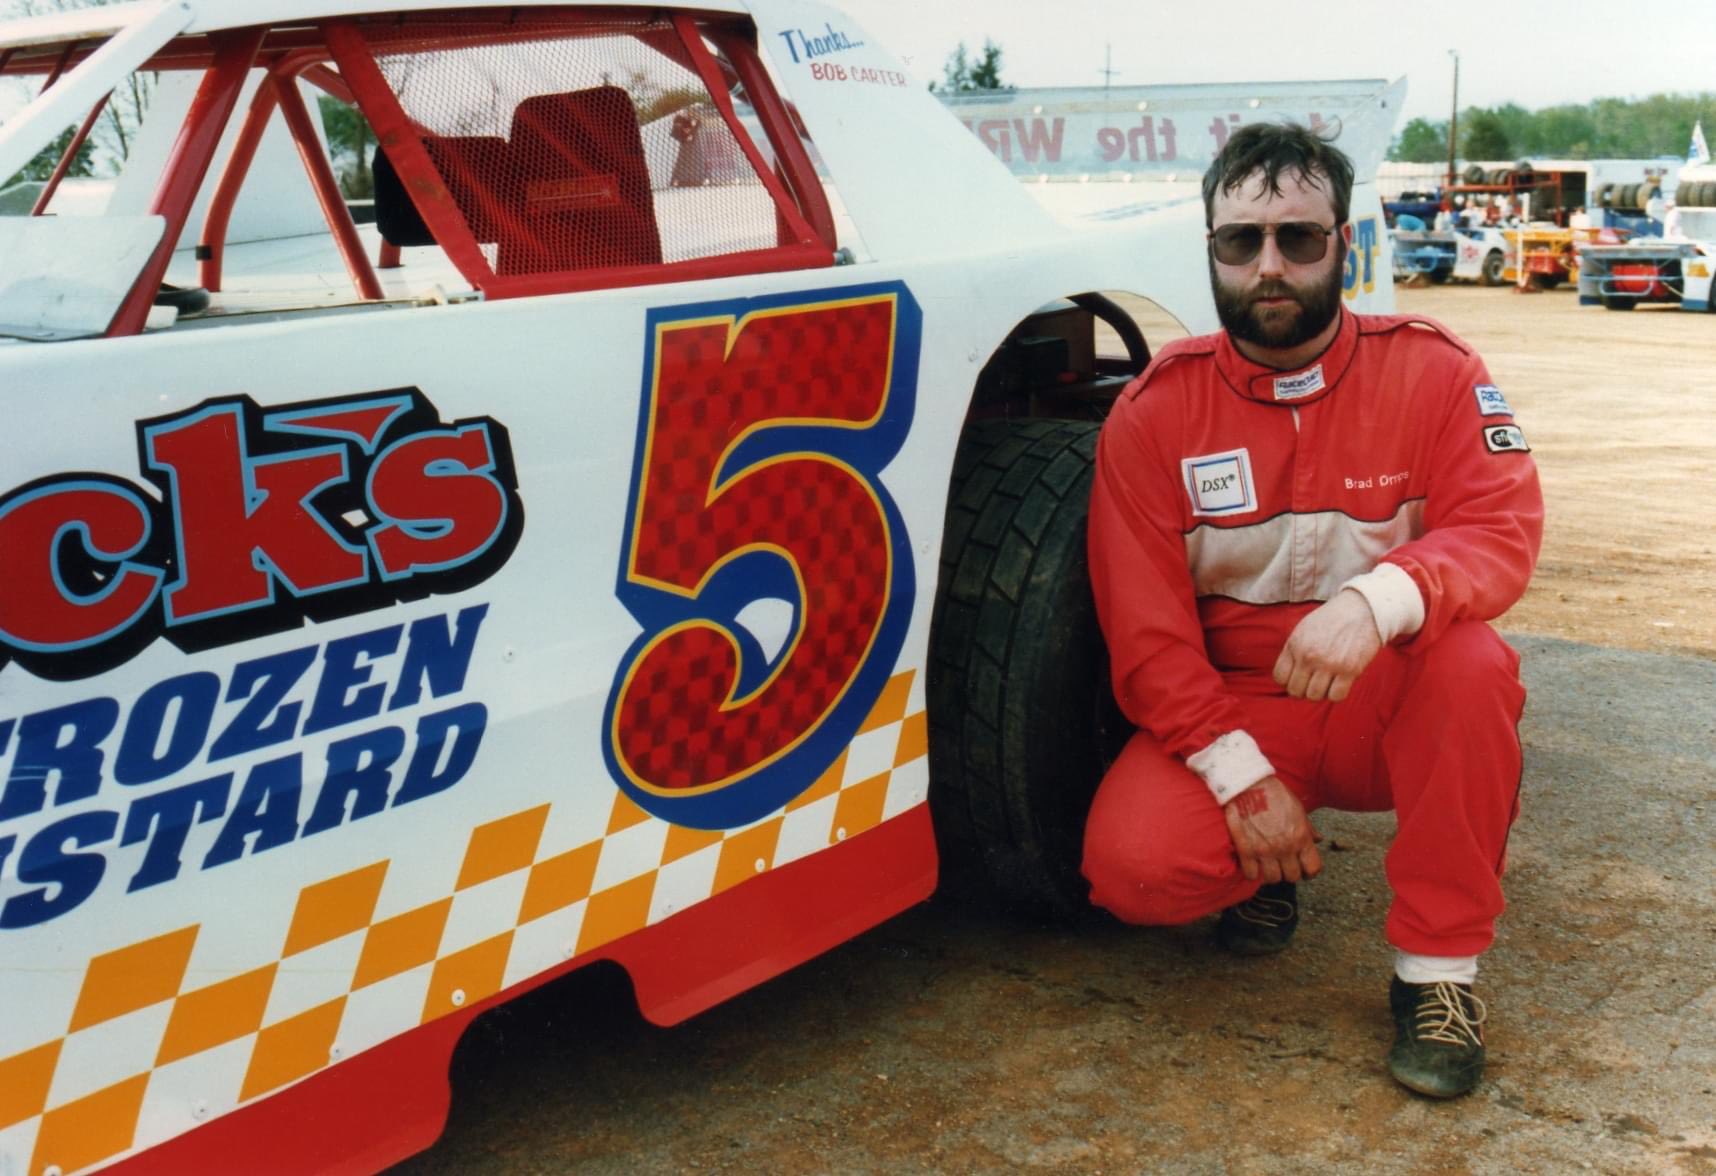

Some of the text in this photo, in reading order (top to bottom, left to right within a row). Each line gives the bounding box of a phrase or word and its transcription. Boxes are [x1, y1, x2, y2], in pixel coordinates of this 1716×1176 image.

[811, 63, 908, 88] BOB CARTER
[1345, 477, 1373, 489] Brad
[601, 280, 922, 830] 5
